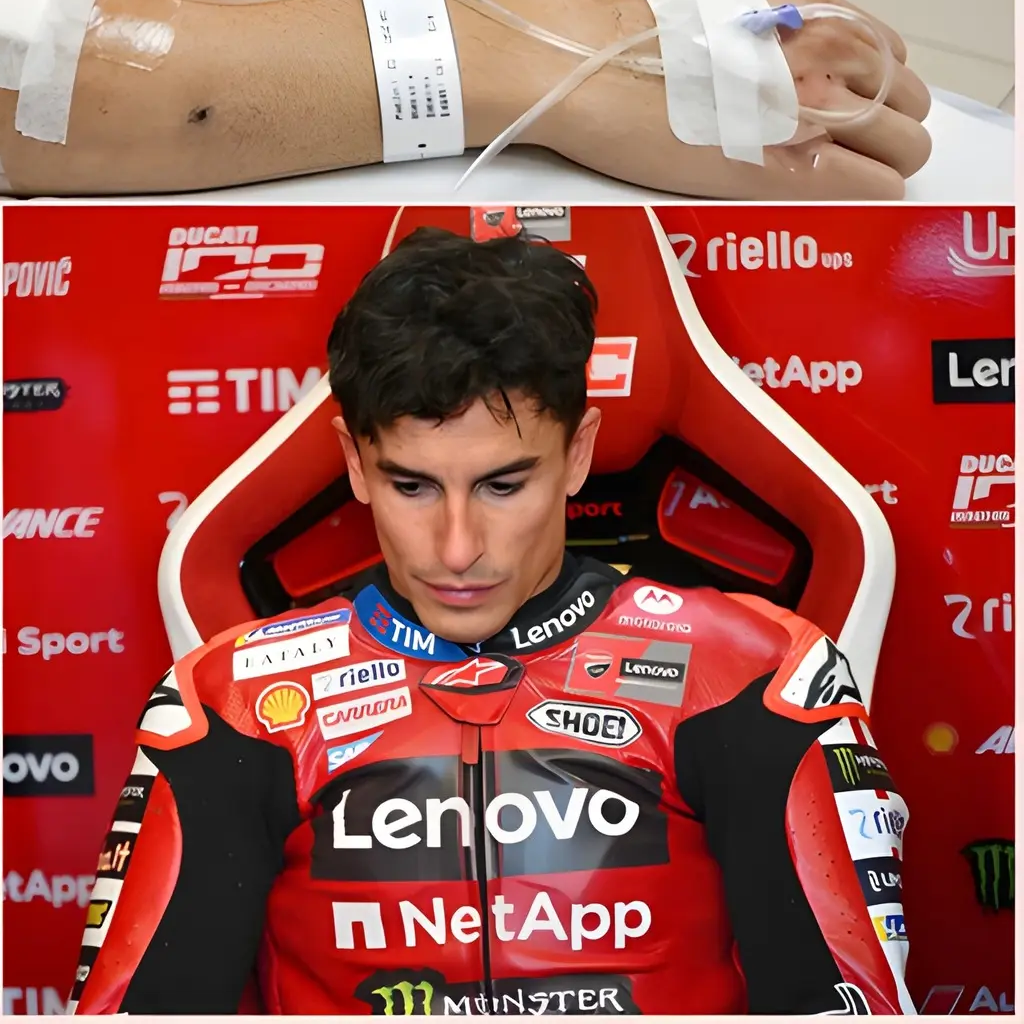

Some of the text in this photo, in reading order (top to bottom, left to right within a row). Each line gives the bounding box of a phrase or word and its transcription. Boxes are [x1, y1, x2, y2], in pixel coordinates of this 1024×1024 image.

[707, 230, 818, 271] riello
[732, 355, 863, 393] etApp
[960, 454, 1015, 473] DUC
[391, 618, 436, 655] TIM
[511, 590, 596, 649] Lenovo
[17, 626, 125, 660] Sport
[339, 662, 400, 687] riello
[546, 708, 626, 740] SHOEI
[332, 787, 640, 850] Lenovo
[399, 892, 652, 951] NetApp
